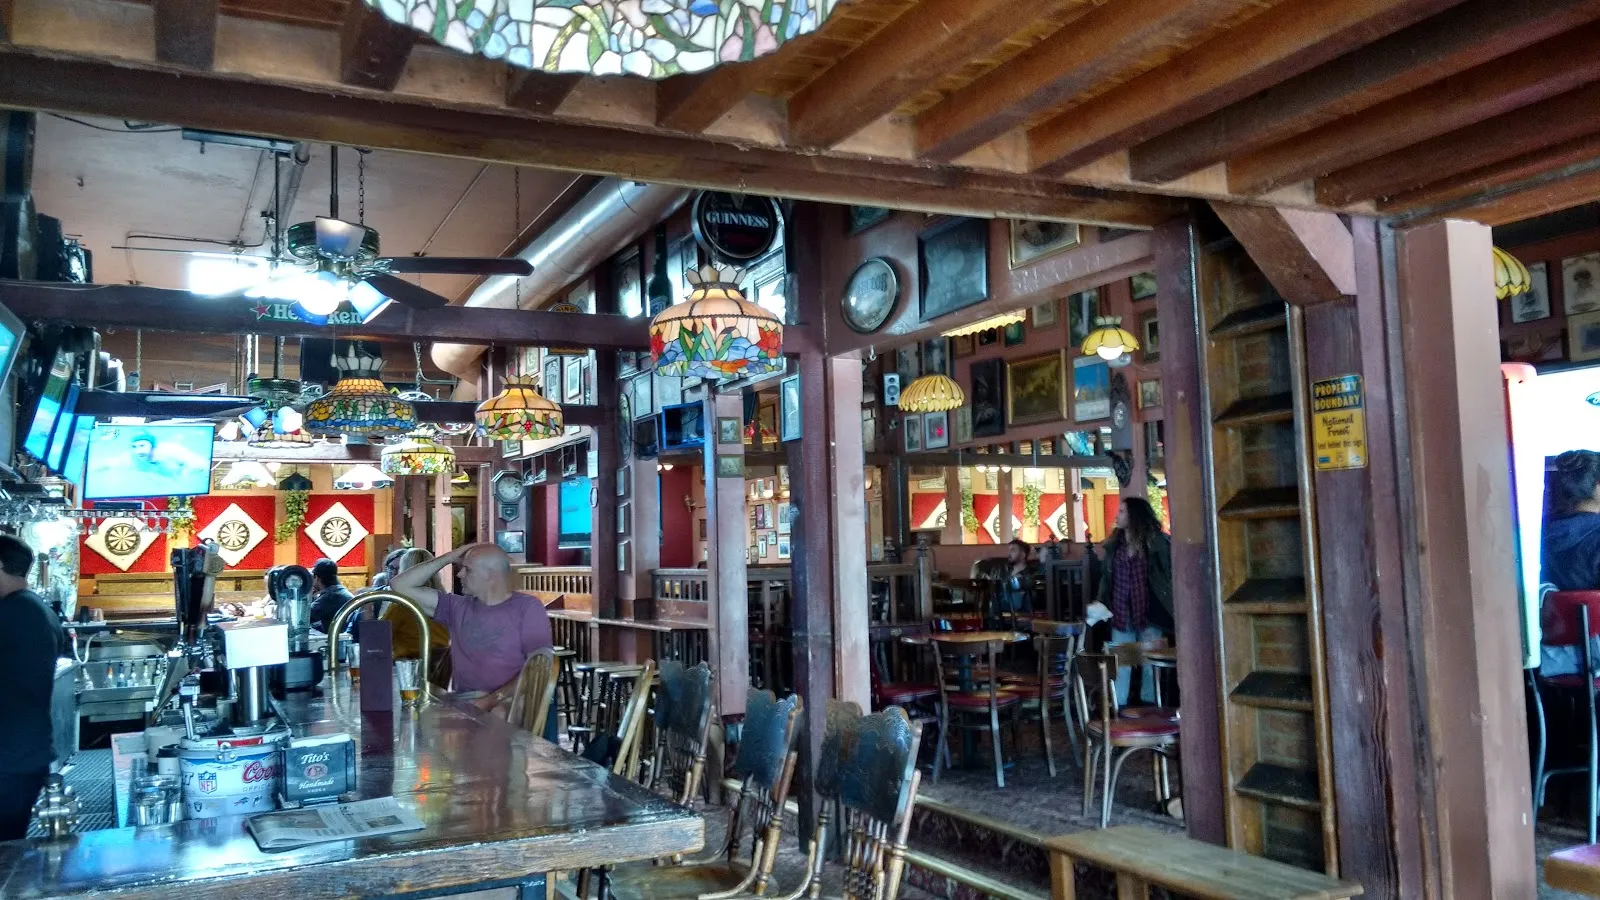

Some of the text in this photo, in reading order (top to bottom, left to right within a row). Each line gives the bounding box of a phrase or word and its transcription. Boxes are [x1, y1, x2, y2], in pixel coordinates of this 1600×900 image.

[705, 211, 769, 228] GUINNESS
[273, 303, 362, 324] Heken
[1315, 381, 1358, 397] PROPERTY
[1314, 394, 1360, 411] BOUNDARY
[1322, 413, 1354, 427] National
[1327, 426, 1350, 437] Forest
[301, 751, 330, 765] Tito's
[242, 760, 281, 783] Coo
[200, 780, 216, 792] NFL
[298, 776, 335, 790] Handmade
